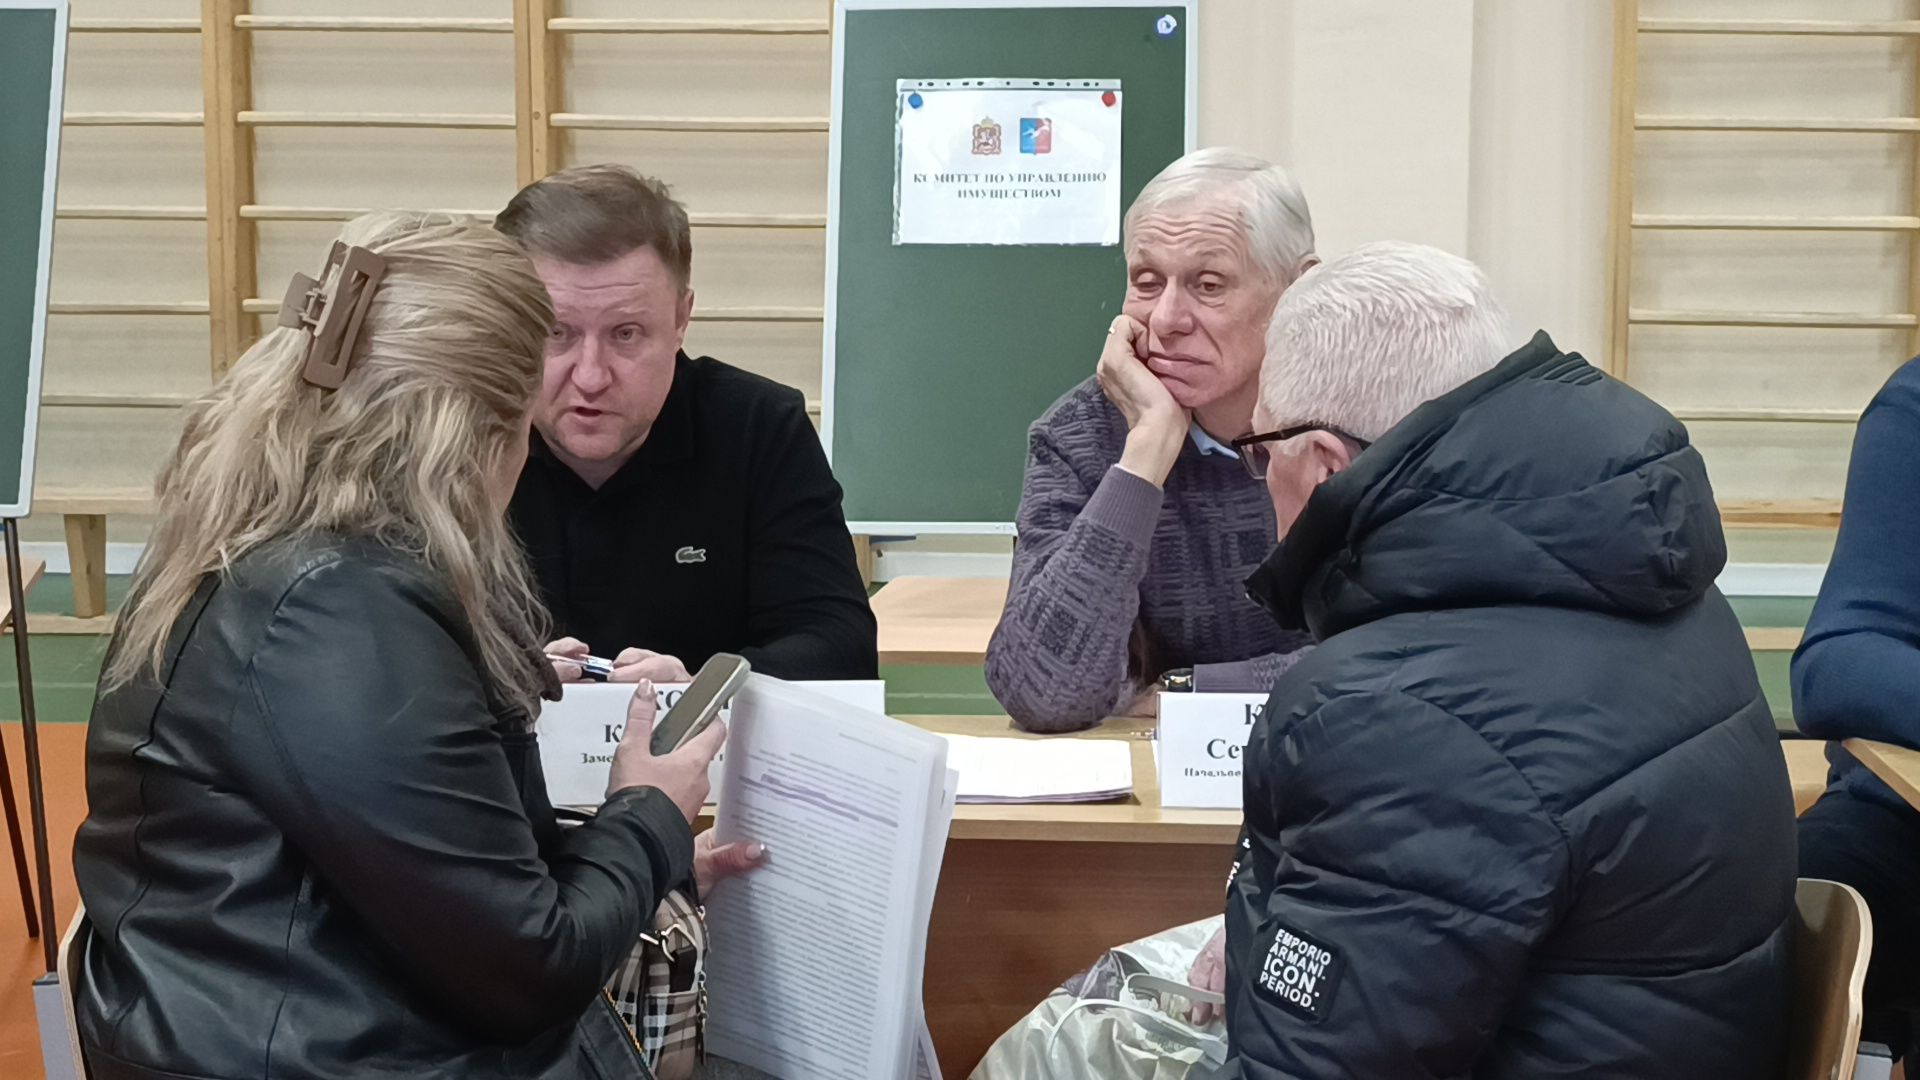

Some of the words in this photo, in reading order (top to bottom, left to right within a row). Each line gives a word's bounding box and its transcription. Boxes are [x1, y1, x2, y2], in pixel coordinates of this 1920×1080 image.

[958, 189, 1061, 199] ИМУЩЕСТВОМ
[984, 173, 1004, 183] ПО
[1009, 172, 1106, 183] УПРАВЛЕНИЮ
[1275, 928, 1331, 966] EMPORIO
[1259, 971, 1315, 1011] PERIOD.
[1263, 953, 1320, 998] ICON.
